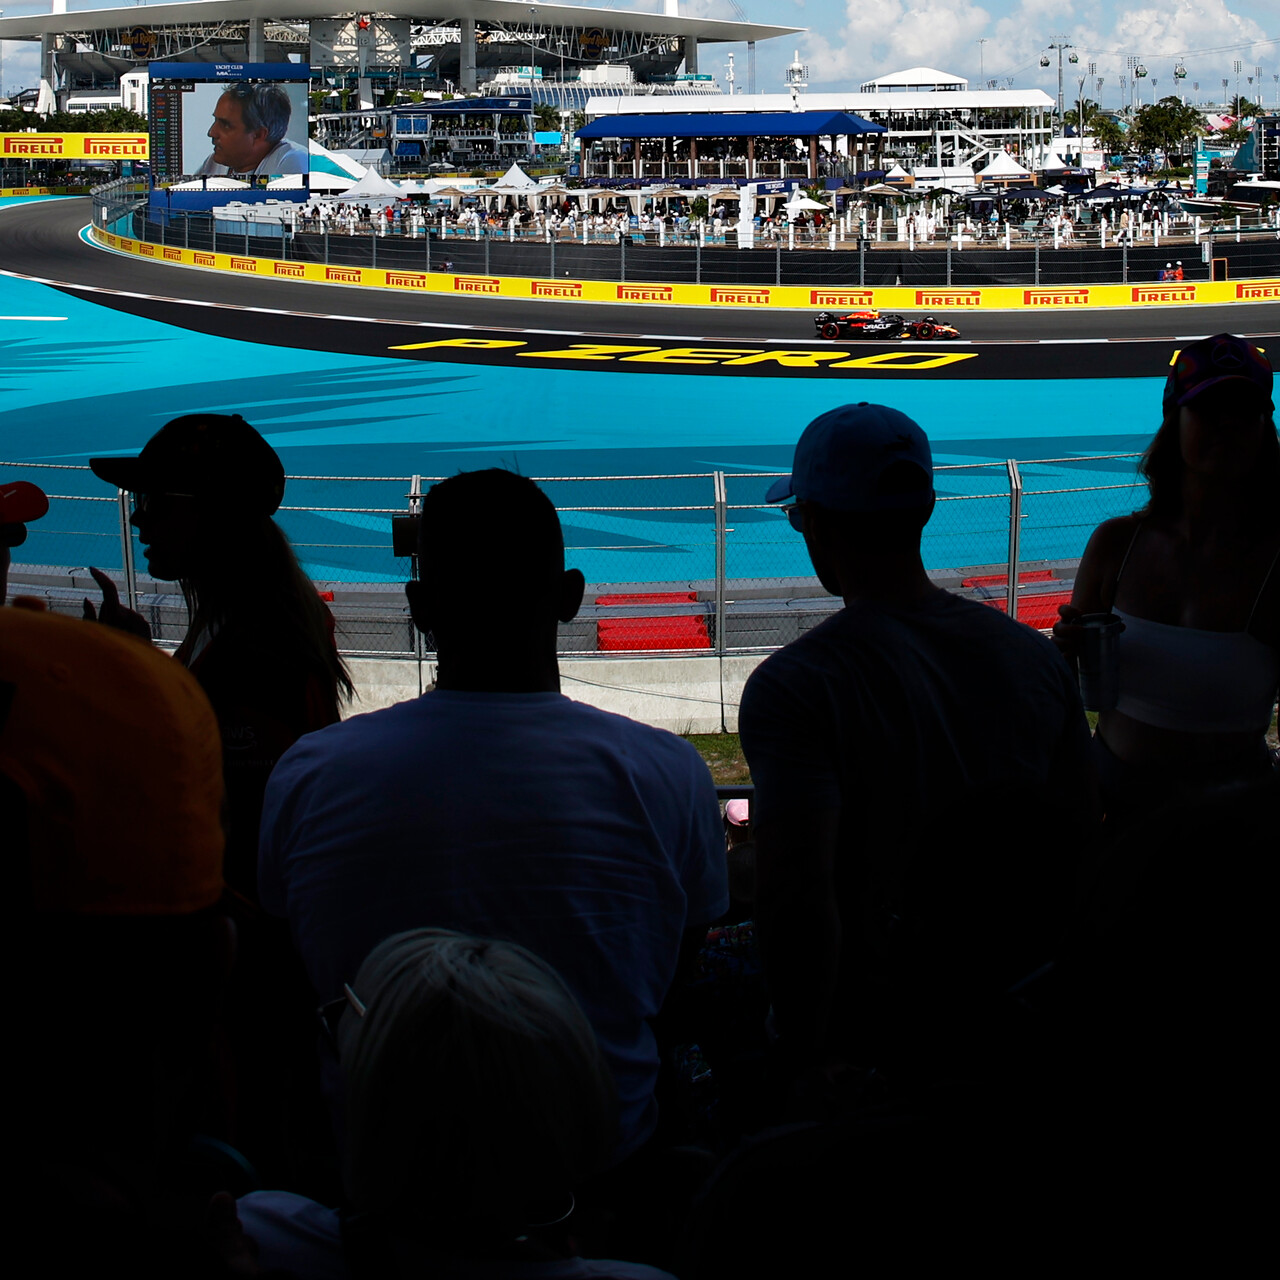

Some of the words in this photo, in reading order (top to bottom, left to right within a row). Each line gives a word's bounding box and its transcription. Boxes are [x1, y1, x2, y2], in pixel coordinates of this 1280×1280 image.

[4, 137, 64, 153] PIRELLI
[84, 138, 147, 154] PIRELLI
[139, 244, 154, 256] PIRELLI
[163, 248, 181, 261] PIRELLI
[194, 253, 215, 266] PIRELLI
[231, 258, 256, 272] PIRELLI
[274, 263, 304, 277] PIRELLI
[326, 268, 361, 282] PIRELLI
[385, 272, 426, 288] PIRELLI
[454, 277, 500, 293] PIRELLI
[531, 282, 582, 297] PIRELLI
[616, 285, 673, 301] PIRELLI
[710, 288, 770, 304] PIRELLI
[1024, 289, 1089, 305] PIRELLI
[1131, 286, 1196, 302] PIRELLI
[810, 290, 873, 306] PIRELLI
[915, 290, 980, 306] PIRELLI
[387, 338, 528, 351] P
[515, 344, 978, 370] ZERO
